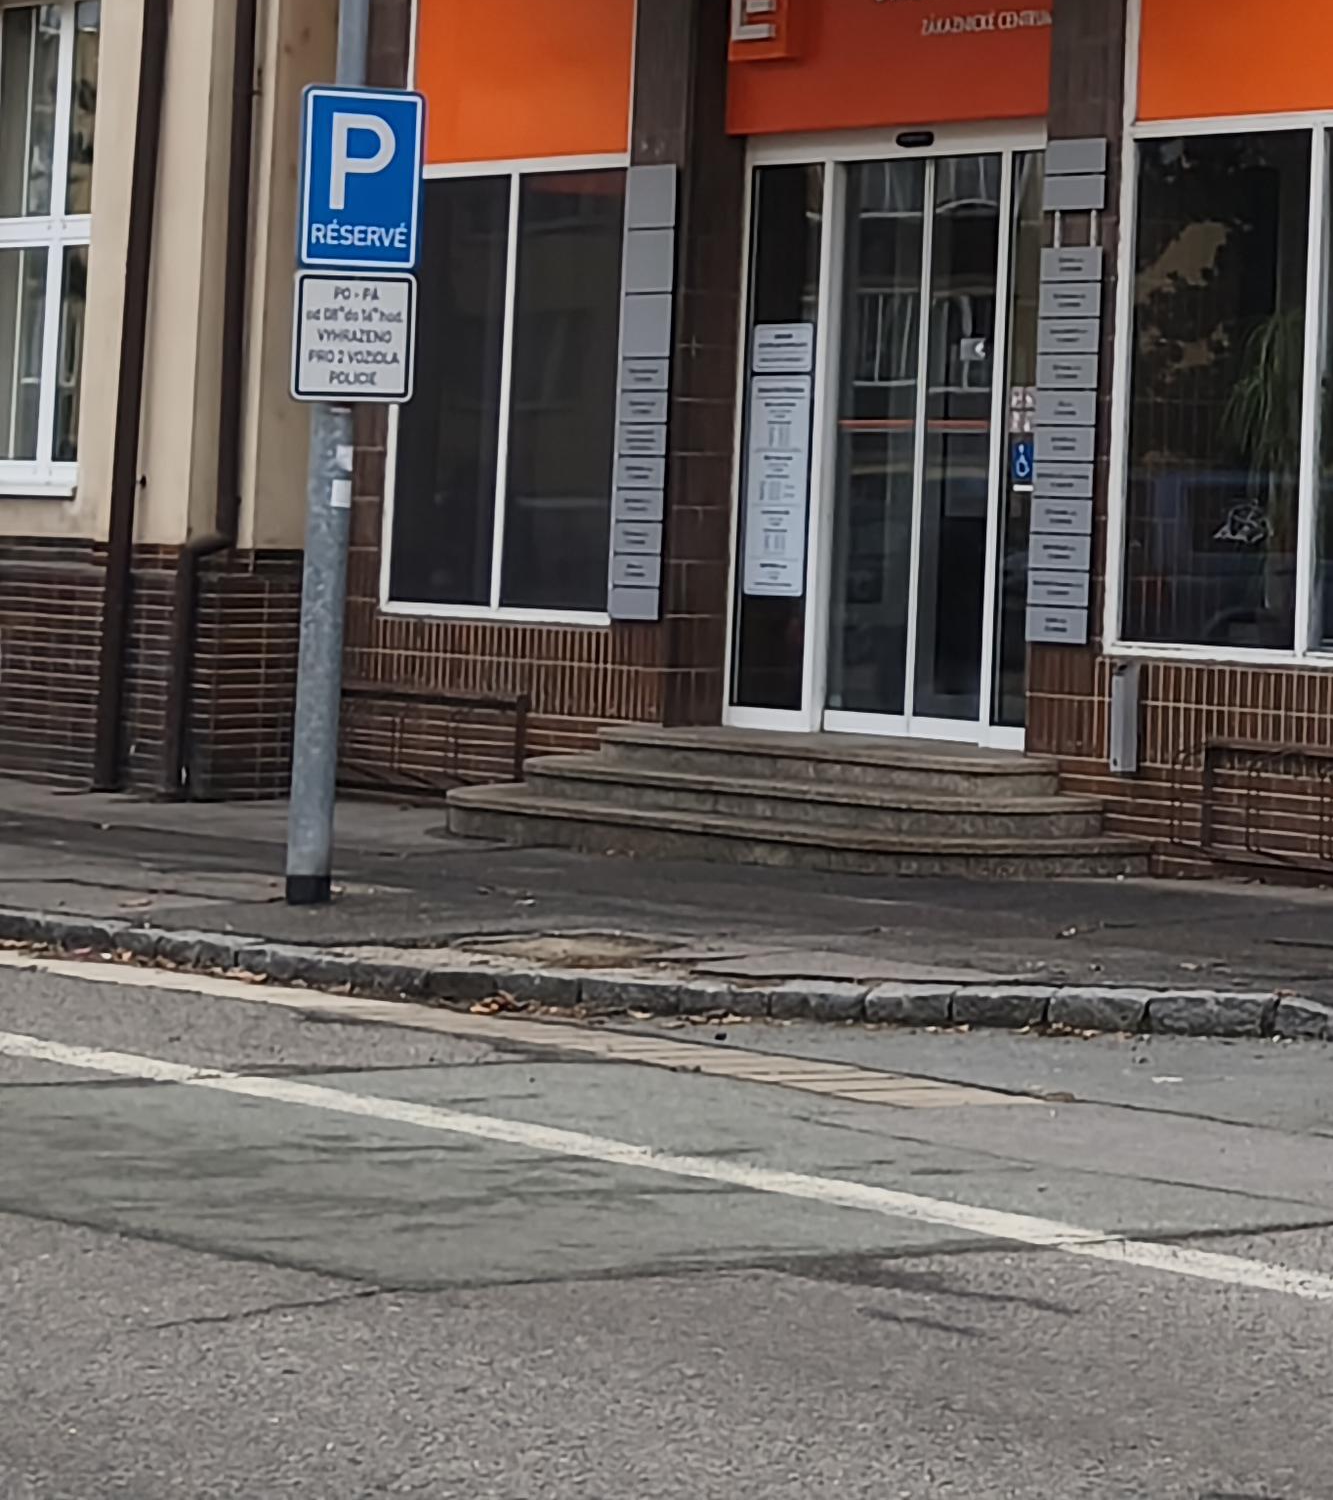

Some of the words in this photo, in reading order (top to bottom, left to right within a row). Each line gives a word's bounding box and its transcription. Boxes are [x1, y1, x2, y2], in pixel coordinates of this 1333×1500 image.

[329, 111, 396, 210] P
[310, 219, 407, 249] RÉSERVÉ
[333, 285, 351, 300] PO
[308, 349, 335, 363] PRO
[347, 350, 400, 365] VOZIDLA
[329, 370, 377, 386] POLICIE
